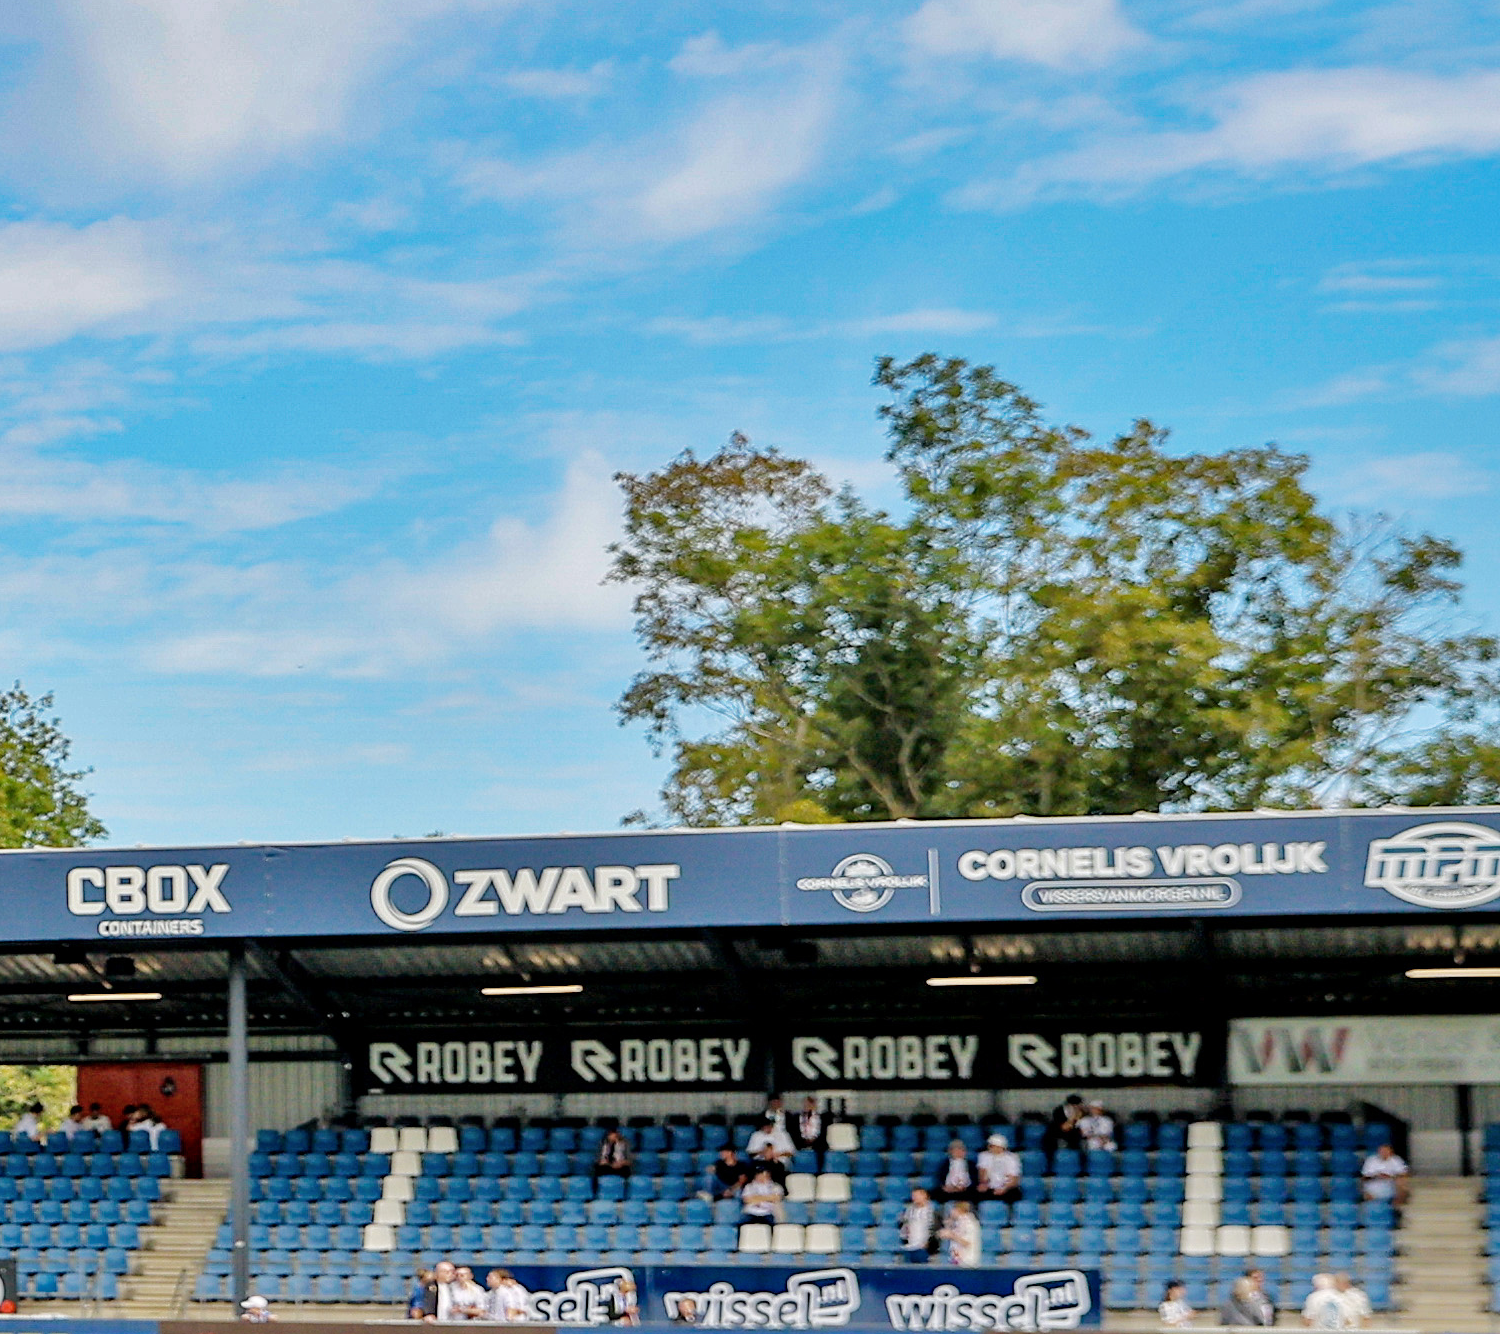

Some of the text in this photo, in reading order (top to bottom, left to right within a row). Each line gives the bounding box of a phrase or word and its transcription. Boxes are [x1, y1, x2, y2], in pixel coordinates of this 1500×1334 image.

[958, 841, 1330, 881] CORNELIS VROLIJK
[67, 864, 232, 915] CBOX
[98, 919, 204, 937] CONTAINERS
[417, 1040, 543, 1084] ROBEY
[620, 1038, 750, 1082] ROBEY
[844, 1035, 979, 1080] ROBEY
[1060, 1031, 1200, 1078] ROBEY
